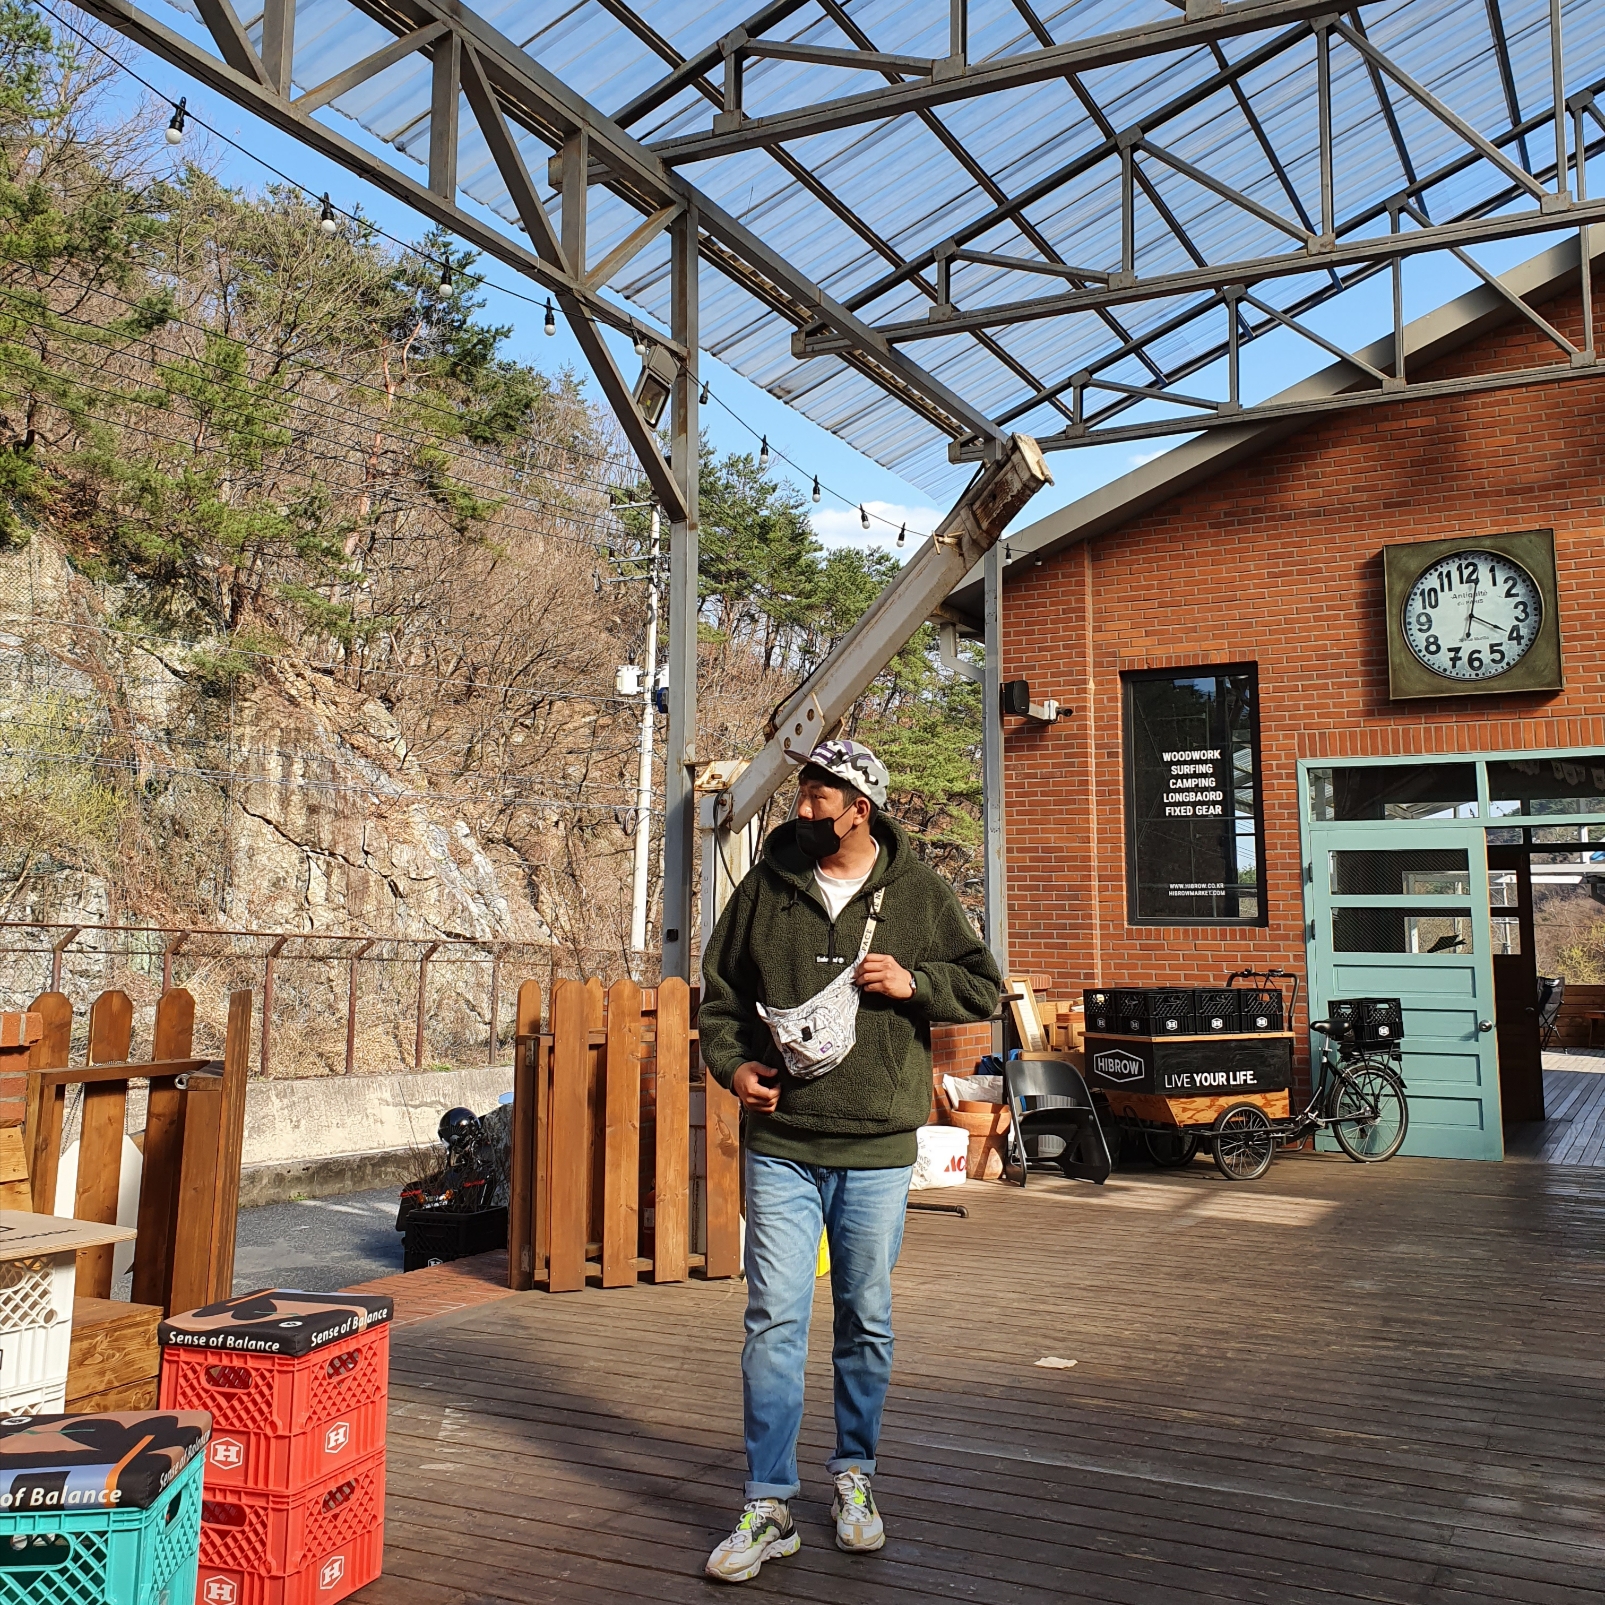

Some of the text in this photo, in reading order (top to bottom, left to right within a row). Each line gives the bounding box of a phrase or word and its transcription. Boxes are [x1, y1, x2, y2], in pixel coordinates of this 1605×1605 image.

[1437, 570, 1452, 592] 11
[1457, 562, 1479, 584] 12
[1489, 565, 1497, 587] 1
[1503, 576, 1519, 598] 2
[1419, 587, 1439, 610] 10
[1416, 612, 1433, 633] 9
[1514, 601, 1529, 623] 3
[1425, 634, 1441, 655] 8
[1508, 624, 1524, 646] 4
[1447, 646, 1463, 669] 7
[1467, 650, 1483, 671] 6
[1489, 642, 1506, 664] 5
[1162, 749, 1221, 762] WOODWORK
[1171, 764, 1213, 775] SURFING
[1169, 778, 1216, 789] CAMPING
[1163, 791, 1223, 803] LONGBAORD
[1166, 805, 1222, 816] FIXED GEAR
[1097, 1057, 1139, 1075] HIBROW
[1165, 1070, 1257, 1089] LIVE YOUR LIFE.
[944, 1155, 967, 1172] AC
[311, 1307, 388, 1347] Sense of Balance
[168, 1331, 280, 1353] Sense of Balance
[329, 1427, 347, 1448] H
[214, 1444, 240, 1463] H
[0, 1485, 122, 1507] of Balance
[323, 1561, 342, 1584] H
[207, 1583, 233, 1601] H
